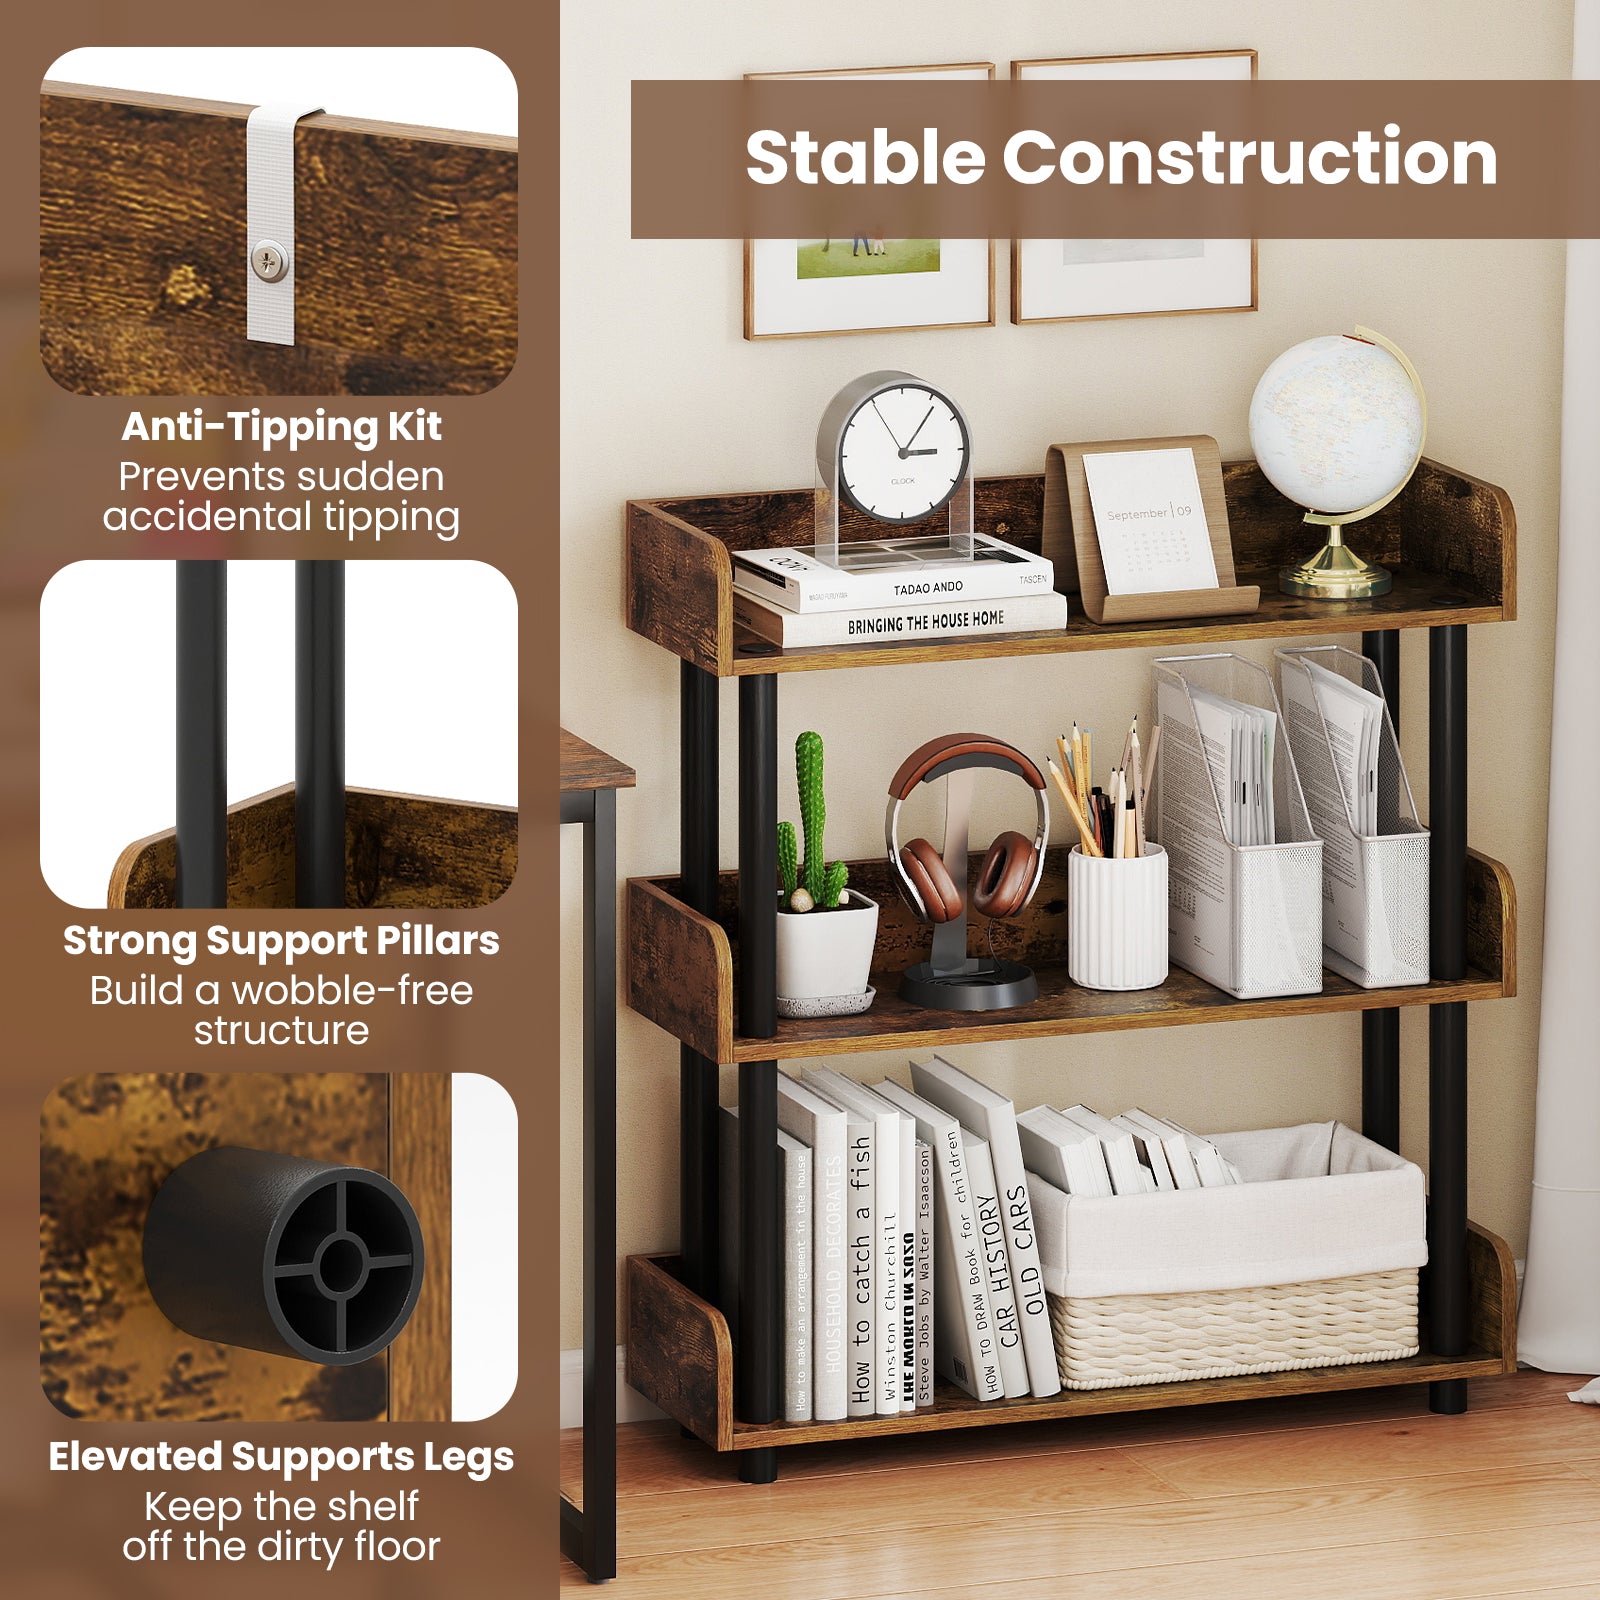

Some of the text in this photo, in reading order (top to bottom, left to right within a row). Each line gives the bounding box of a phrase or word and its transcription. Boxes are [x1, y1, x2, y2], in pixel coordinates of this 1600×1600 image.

[891, 477, 916, 486] CLOCK
[1107, 508, 1168, 522] September
[848, 610, 1005, 635] BRINGING THE HOUSE HOME
[894, 580, 964, 596] TADAO ANDO
[795, 1155, 808, 1411] How to make an arrangement in the house
[826, 1155, 841, 1374] HOUSEHOLD DECORATES
[850, 1136, 870, 1404] How to catch a fish
[884, 1212, 897, 1401] Winston Churchill
[918, 1150, 932, 1401] Steve Jobs by Walter Isaacson
[948, 1130, 999, 1394] HOW TO DRAW Book for children
[977, 1195, 1019, 1348] CAR HISTORY
[1006, 1184, 1045, 1316] OLD CARS
